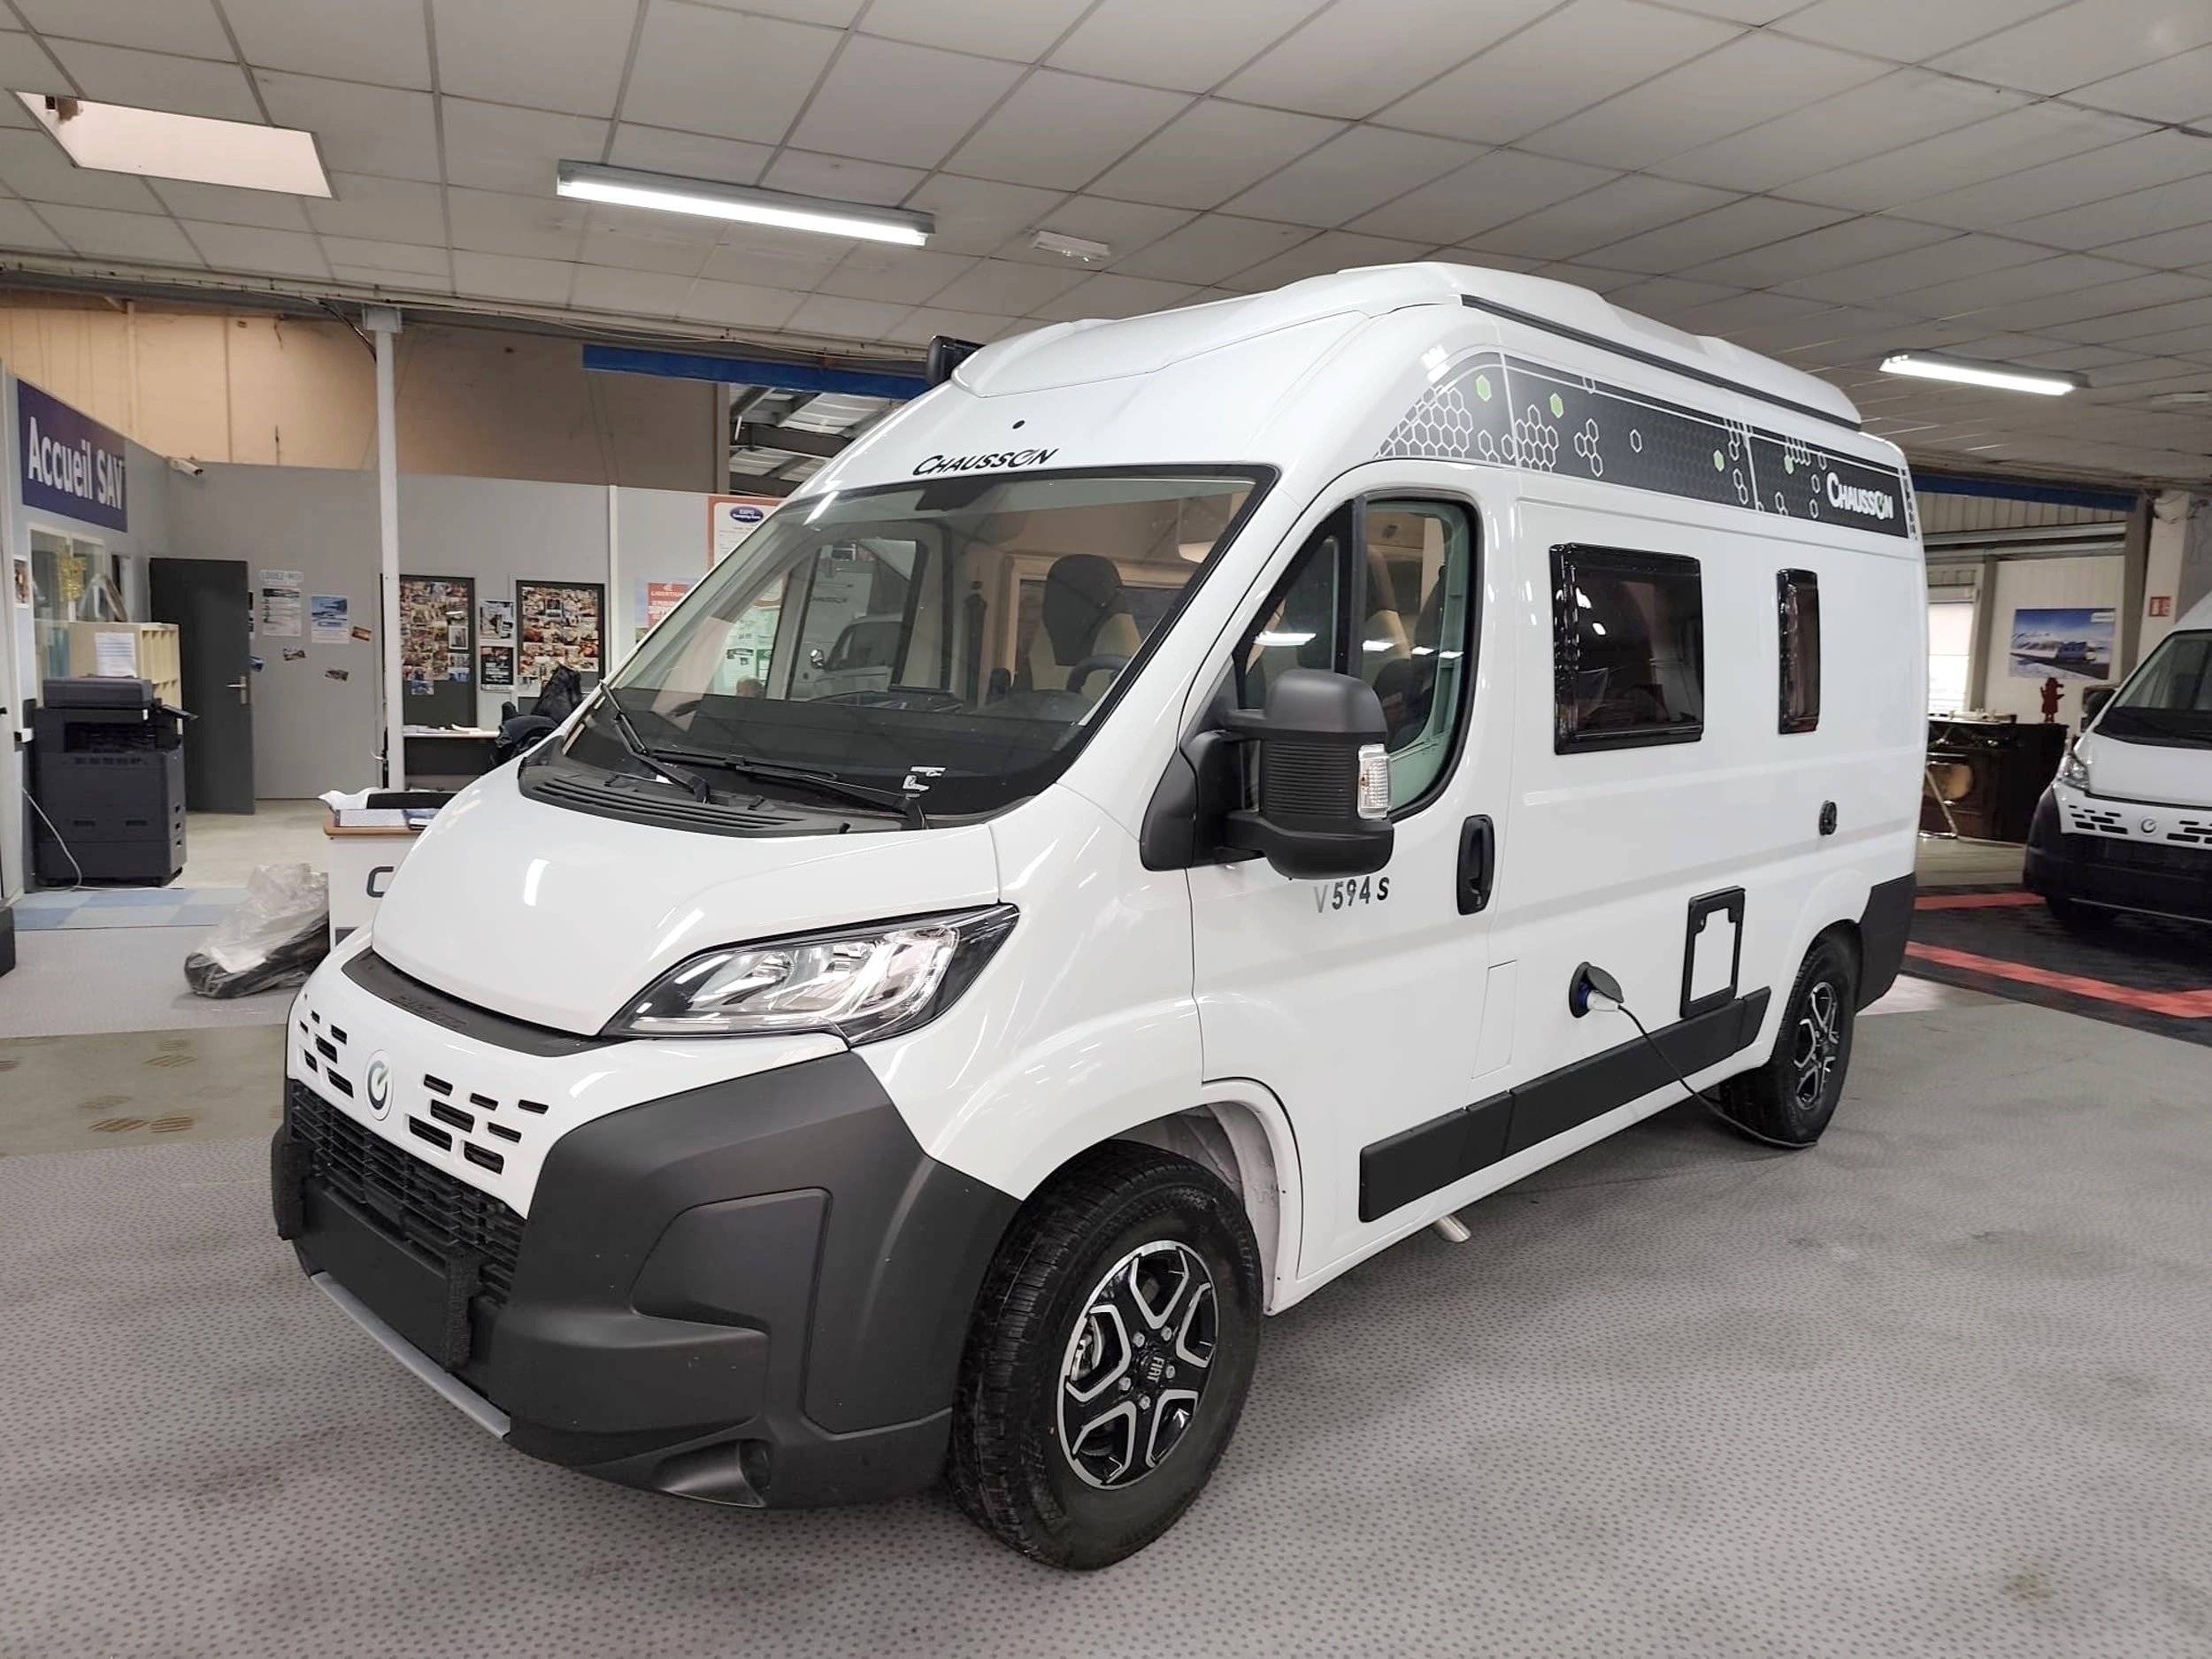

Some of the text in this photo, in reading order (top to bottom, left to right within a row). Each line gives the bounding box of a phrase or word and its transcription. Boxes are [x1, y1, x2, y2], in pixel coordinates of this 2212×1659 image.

[28, 416, 123, 510] Accueil SAV
[912, 449, 1060, 476] CHAUSSON
[1826, 472, 1894, 520] CHAUSSON
[1147, 1356, 1165, 1383] FIAT
